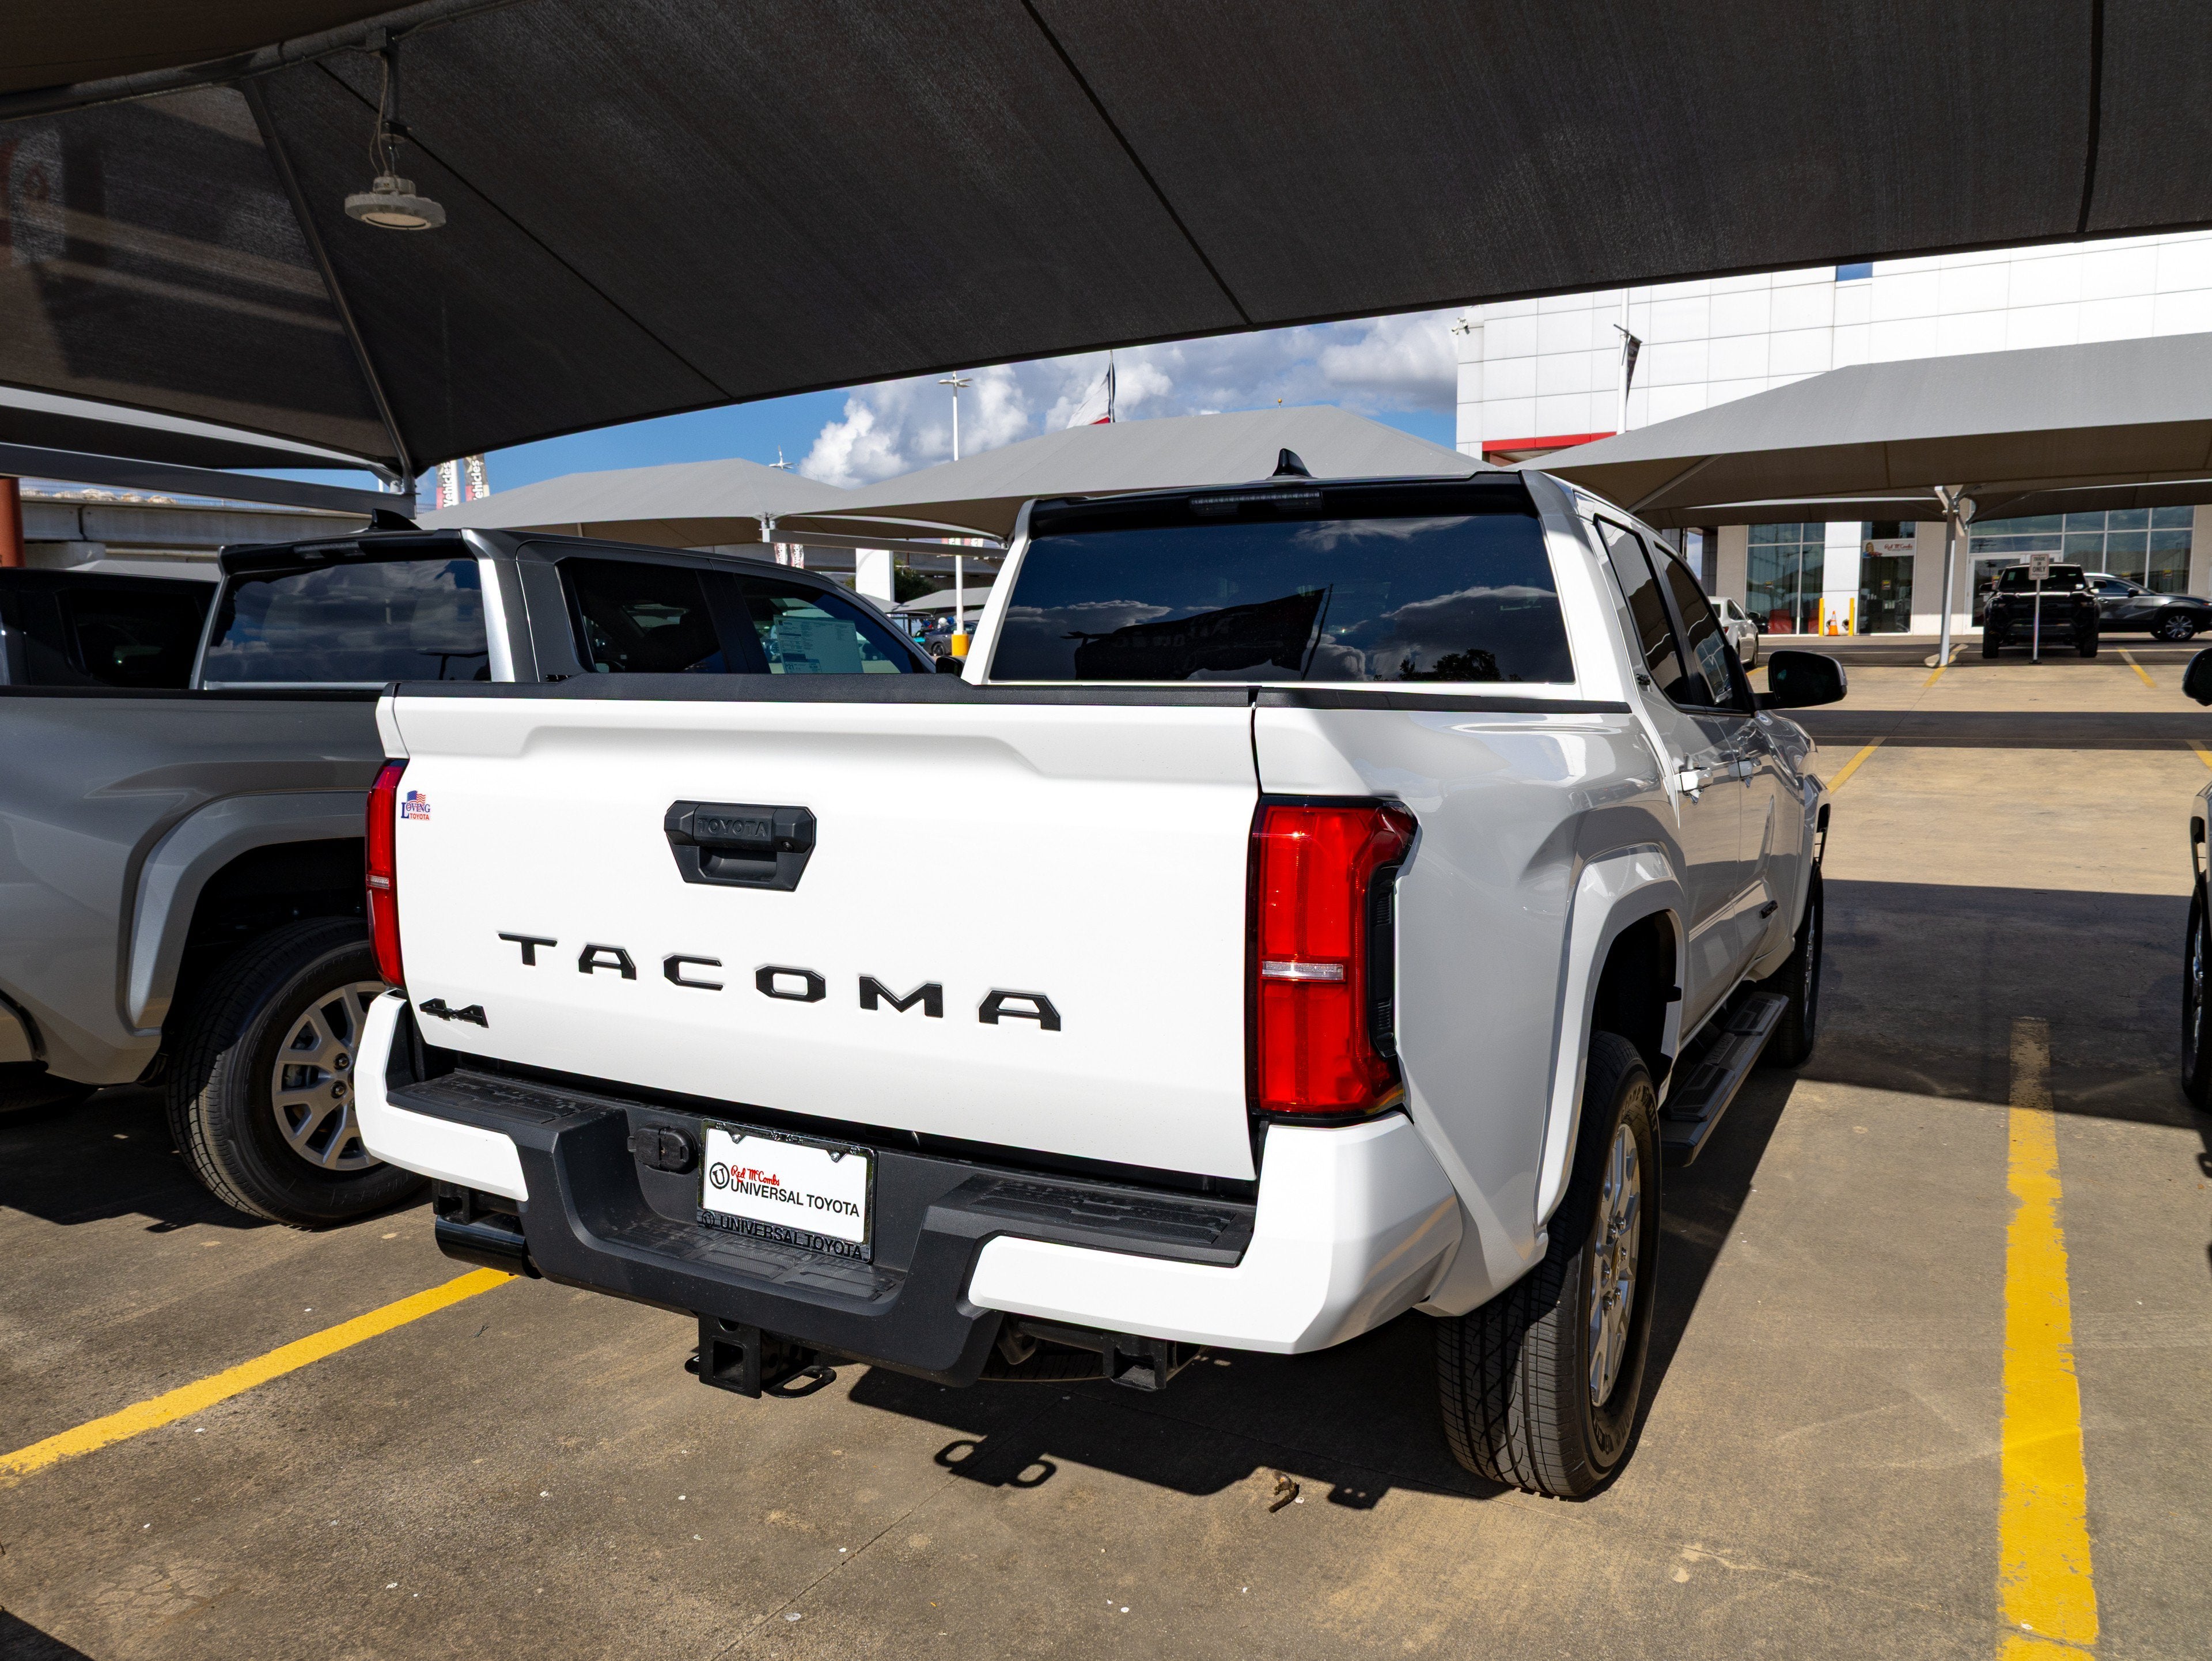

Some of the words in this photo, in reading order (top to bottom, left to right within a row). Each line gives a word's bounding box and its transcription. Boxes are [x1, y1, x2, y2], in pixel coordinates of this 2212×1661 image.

[442, 462, 453, 508] Vehicles
[697, 818, 768, 837] TOYOTA
[497, 932, 1062, 1032] TACOMA
[731, 1165, 745, 1182] Red
[731, 1179, 804, 1206] UNIVERSAL
[806, 1194, 859, 1217] TOYOTA
[720, 1214, 803, 1246] UNIVERSAL
[805, 1234, 863, 1260] TOYOTA
